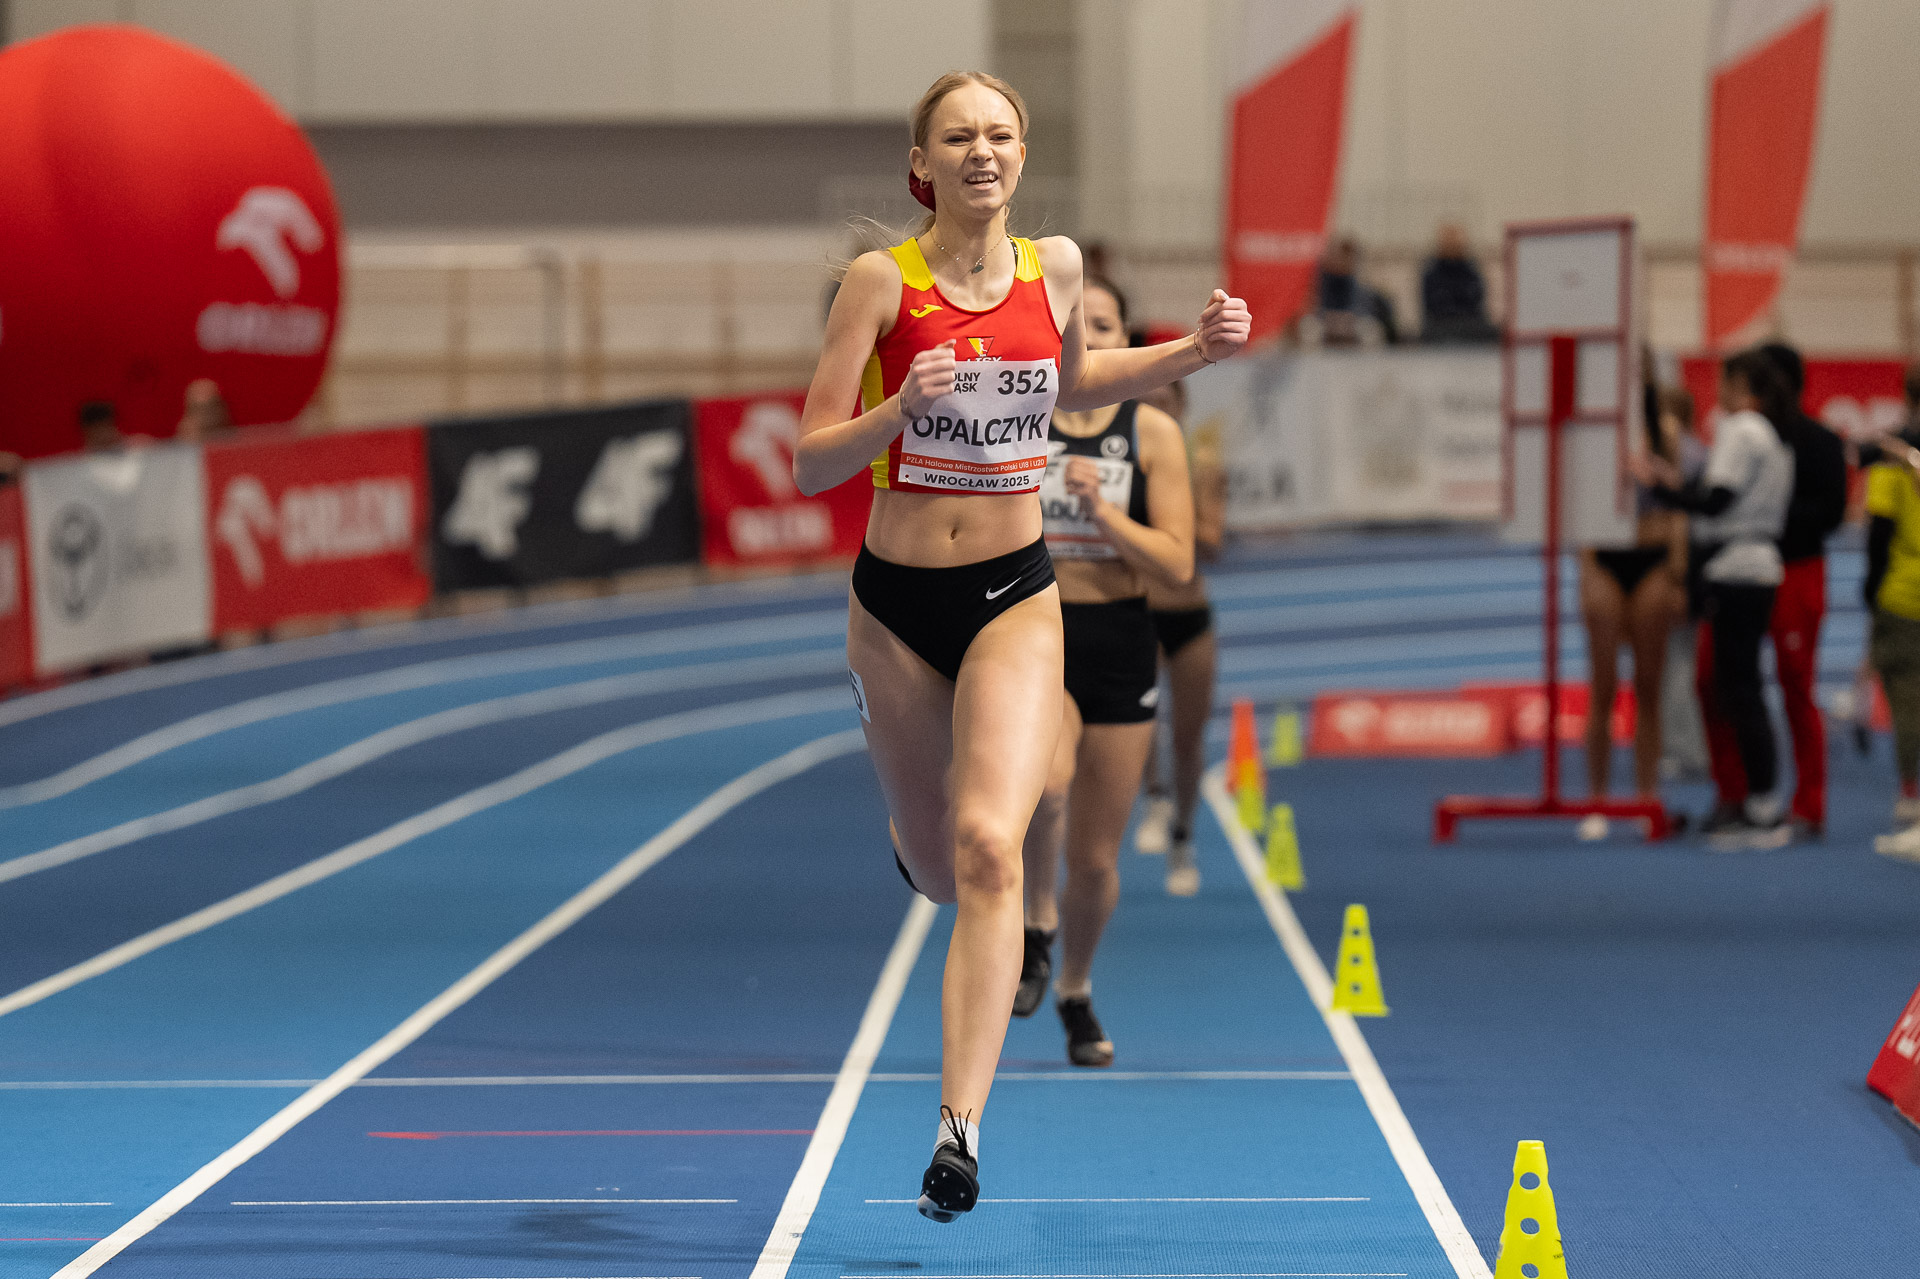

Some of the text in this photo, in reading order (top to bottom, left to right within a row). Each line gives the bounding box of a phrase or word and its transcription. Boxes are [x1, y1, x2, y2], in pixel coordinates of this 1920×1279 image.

[954, 372, 981, 382] LNY
[997, 368, 1048, 395] 352
[954, 383, 977, 394] ĄSK
[912, 412, 1047, 446] OPALCZYK
[906, 456, 923, 465] PZLA
[925, 460, 953, 469] Halowe
[955, 463, 999, 473] Mistrzostwa
[1000, 462, 1018, 472] Polski
[1018, 461, 1029, 469] U18
[1033, 458, 1045, 467] U20
[924, 472, 1030, 488] WROCŁAW 2025
